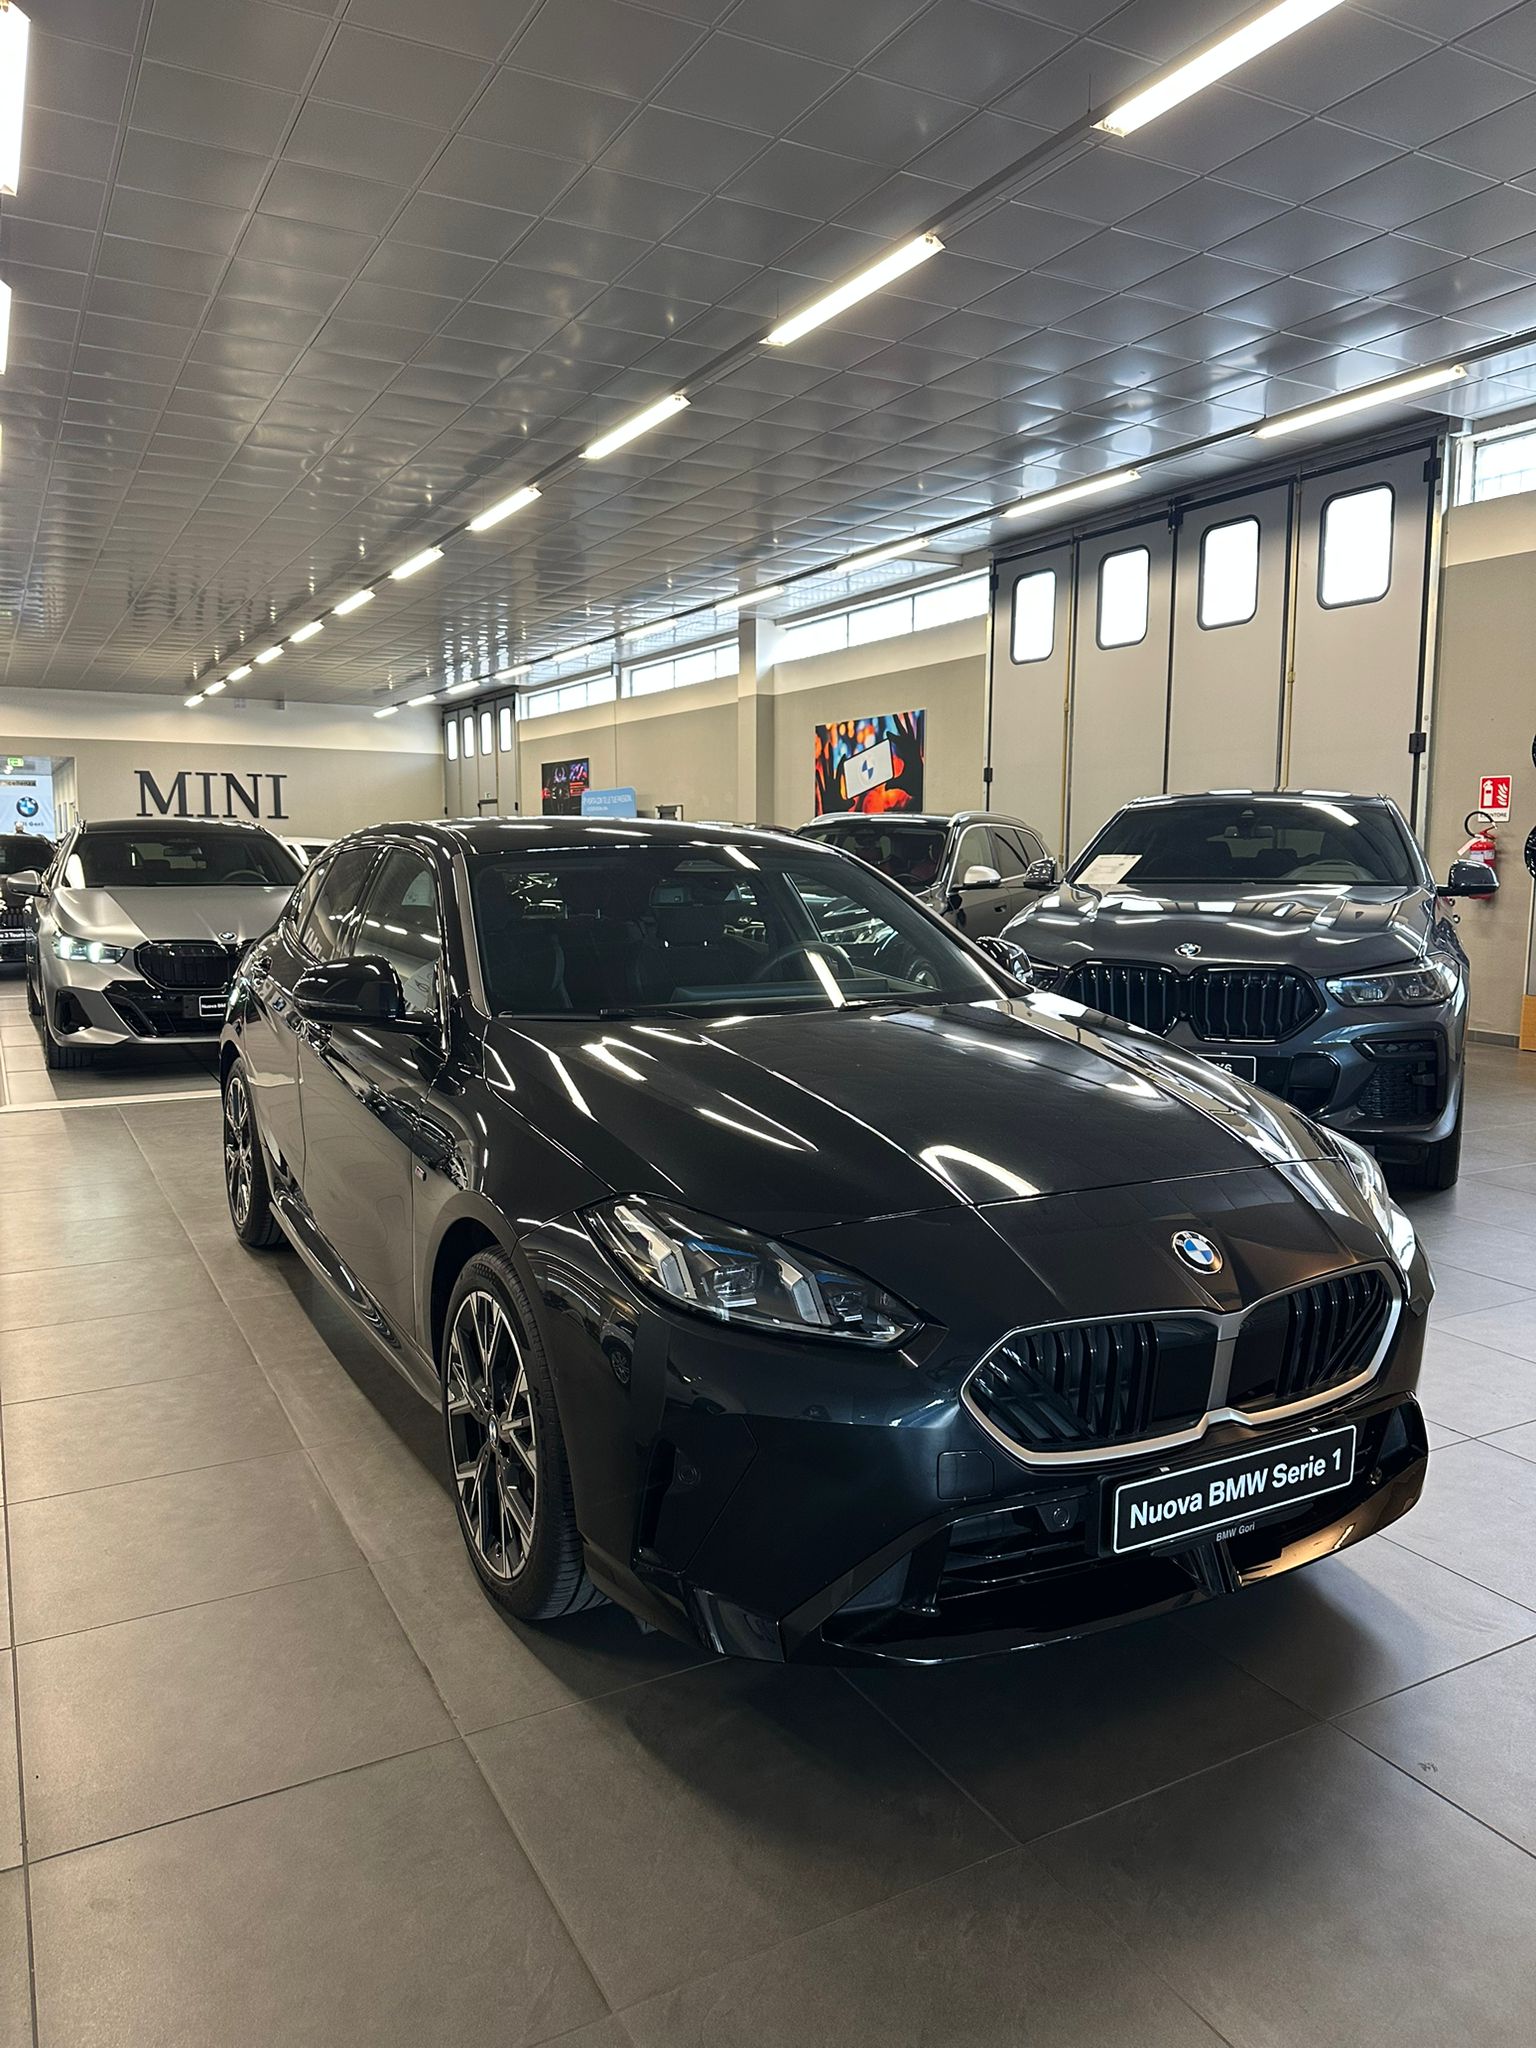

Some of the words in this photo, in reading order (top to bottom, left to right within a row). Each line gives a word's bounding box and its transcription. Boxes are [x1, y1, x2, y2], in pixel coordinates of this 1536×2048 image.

[134, 770, 289, 819] MINI
[1130, 1492, 1203, 1529] Nuova
[1208, 1467, 1268, 1508] BMW
[1272, 1455, 1327, 1488] Serie
[1332, 1448, 1341, 1471] 1
[1216, 1527, 1237, 1542] BMW
[1238, 1521, 1256, 1535] Gori
